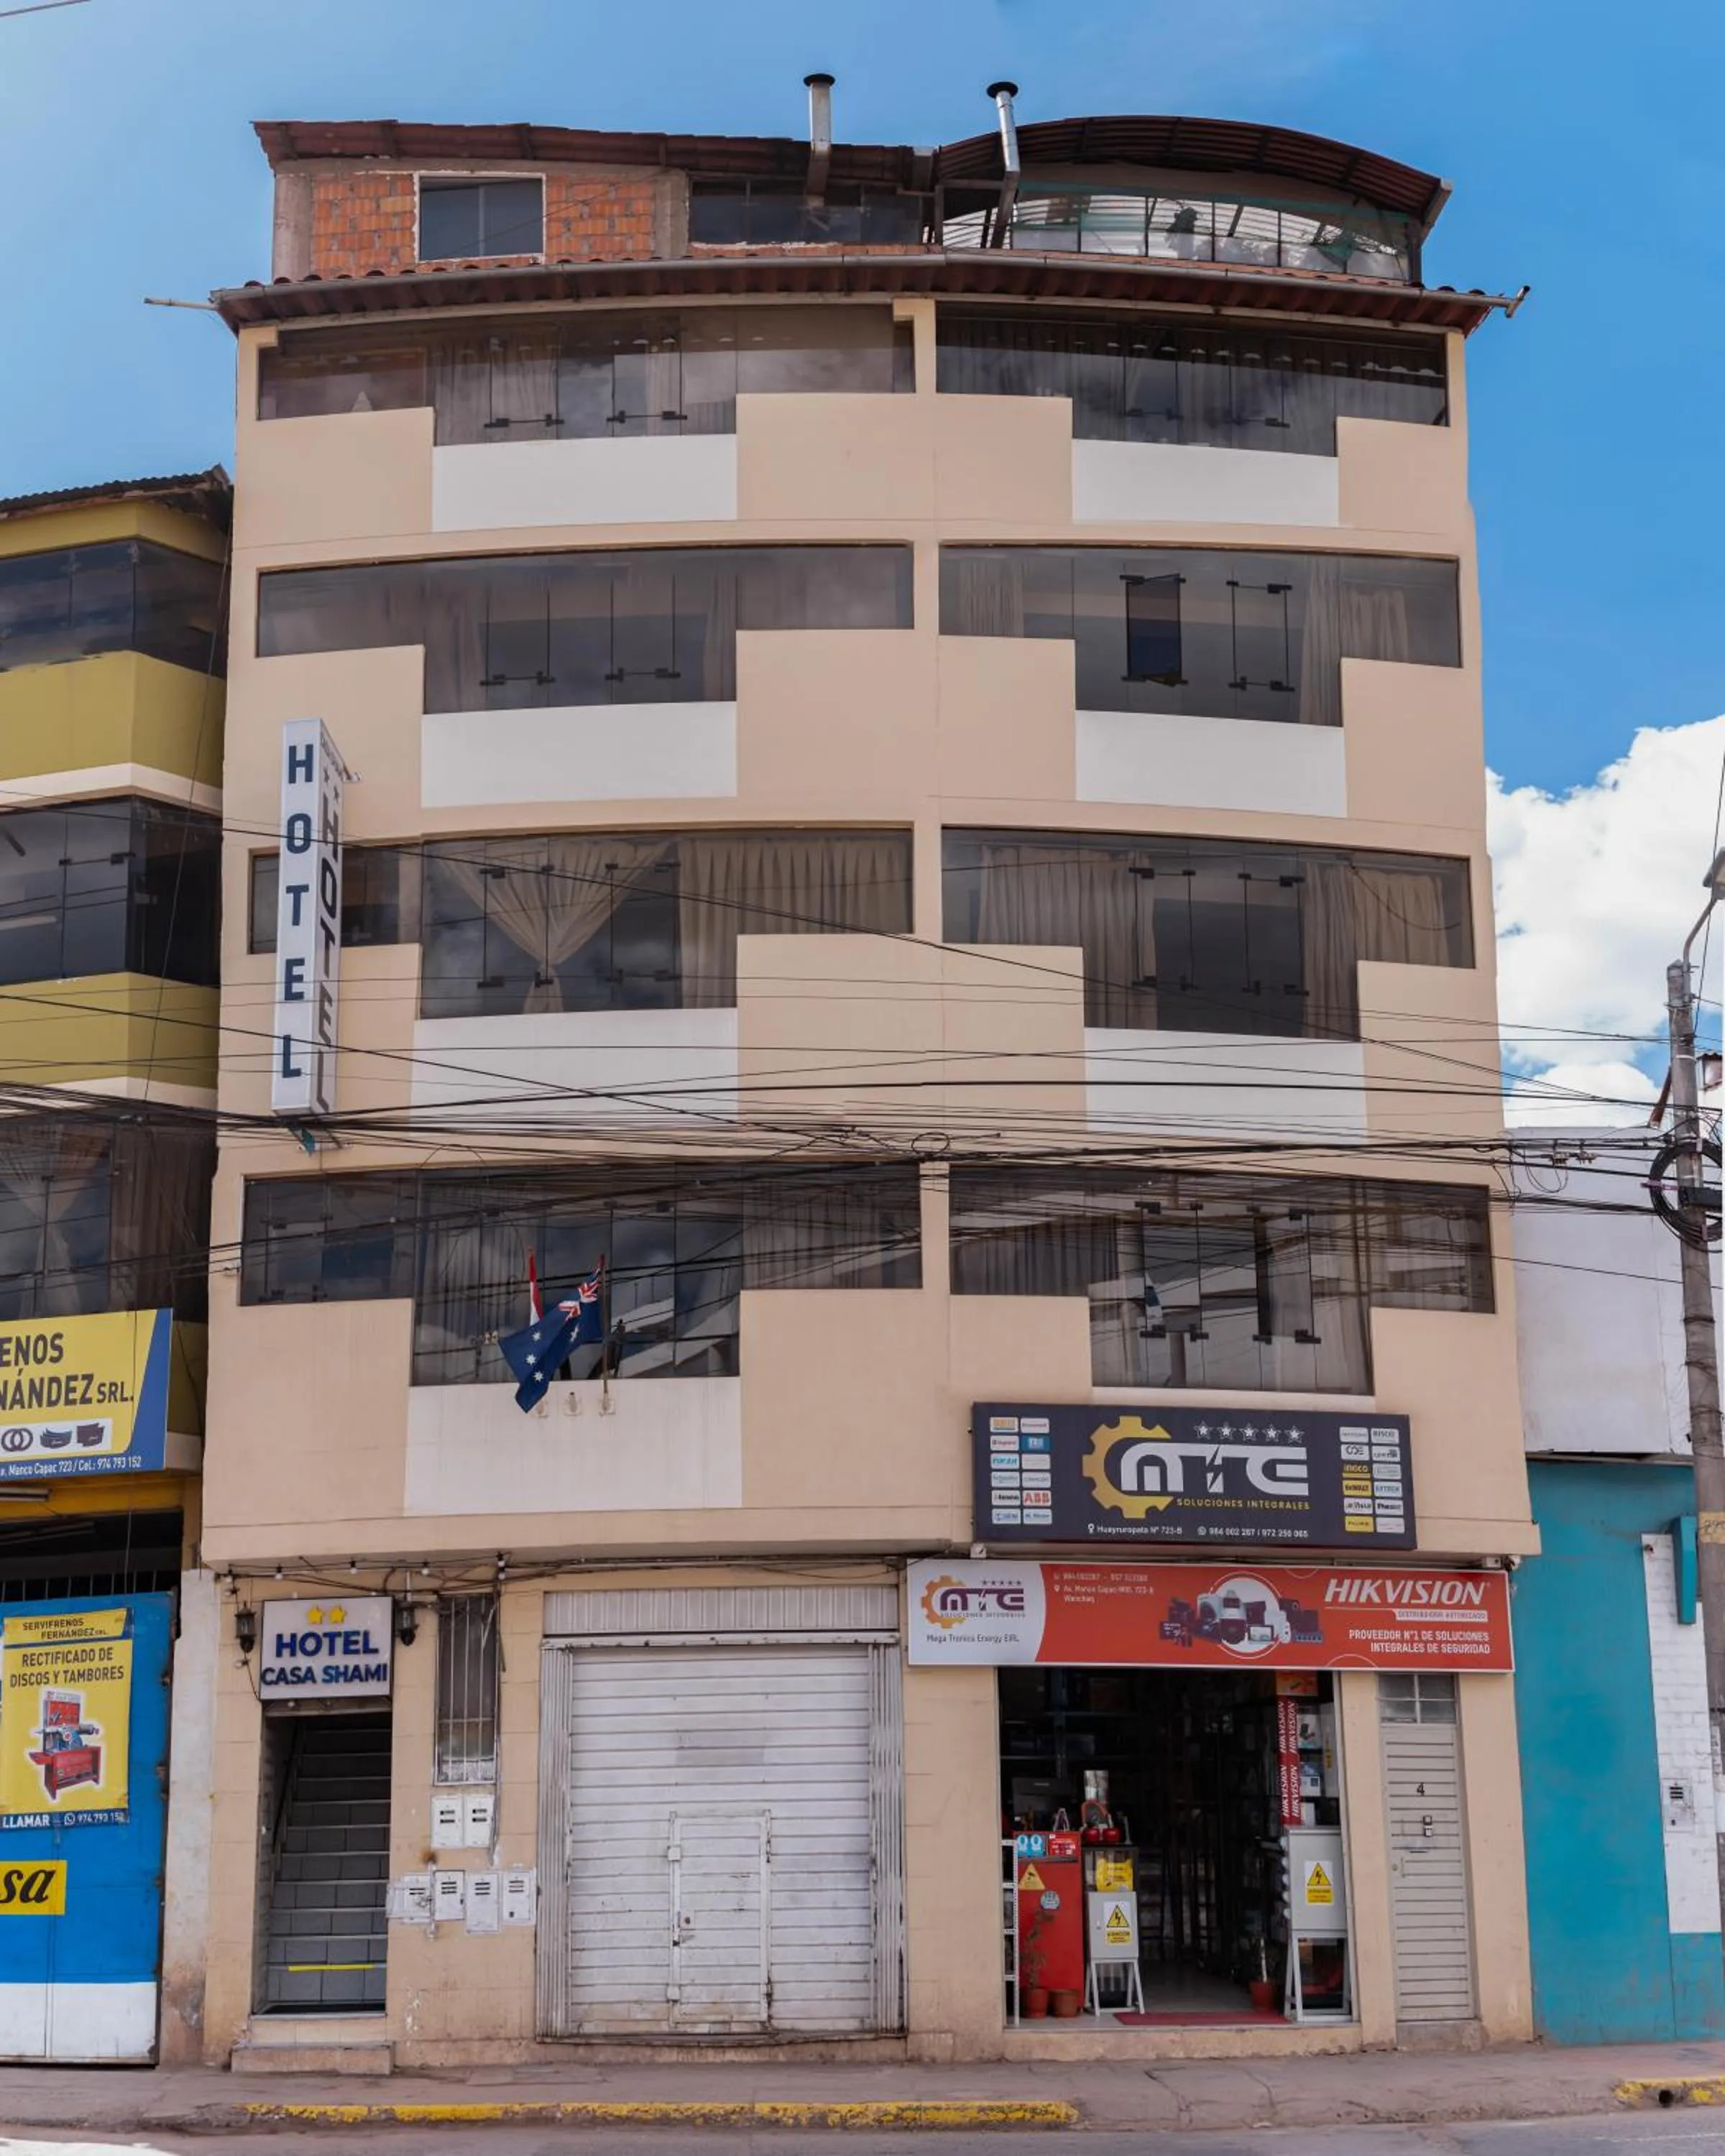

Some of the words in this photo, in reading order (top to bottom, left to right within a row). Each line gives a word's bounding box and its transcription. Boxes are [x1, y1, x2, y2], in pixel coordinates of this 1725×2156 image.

[282, 743, 314, 1079] HOTEL
[316, 791, 339, 1113] HOTEL
[0, 1332, 64, 1367] ENOS
[96, 1381, 134, 1404] SRL.
[9, 1462, 33, 1476] Manco
[1024, 1492, 1051, 1504] ABB
[1176, 1497, 1243, 1508] SOLUCIONES
[1246, 1498, 1311, 1511] INTEGRALES
[1324, 1577, 1486, 1606] HIKVISION
[22, 1618, 84, 1631] SERVIFRENOS
[1348, 1628, 1401, 1640] PROVEEDOR
[1420, 1630, 1433, 1641] DE
[1435, 1631, 1490, 1642] SOLUCIONES
[275, 1629, 380, 1658] HOTEL
[1370, 1641, 1425, 1653] INTEGRALES
[1427, 1642, 1439, 1653] DE
[1441, 1643, 1491, 1654] SEGURIDAD
[22, 1649, 96, 1668] RECTIFICADO
[98, 1646, 114, 1662] DE
[9, 1671, 50, 1689] DISCOS
[52, 1670, 60, 1685] Y
[63, 1665, 124, 1684] TAMBORES
[261, 1665, 318, 1686] CASA
[321, 1662, 389, 1684] SHAMI
[1417, 1782, 1425, 1797] 4
[2, 1814, 50, 1829] LLAMAR
[0, 1869, 57, 1904] sa
